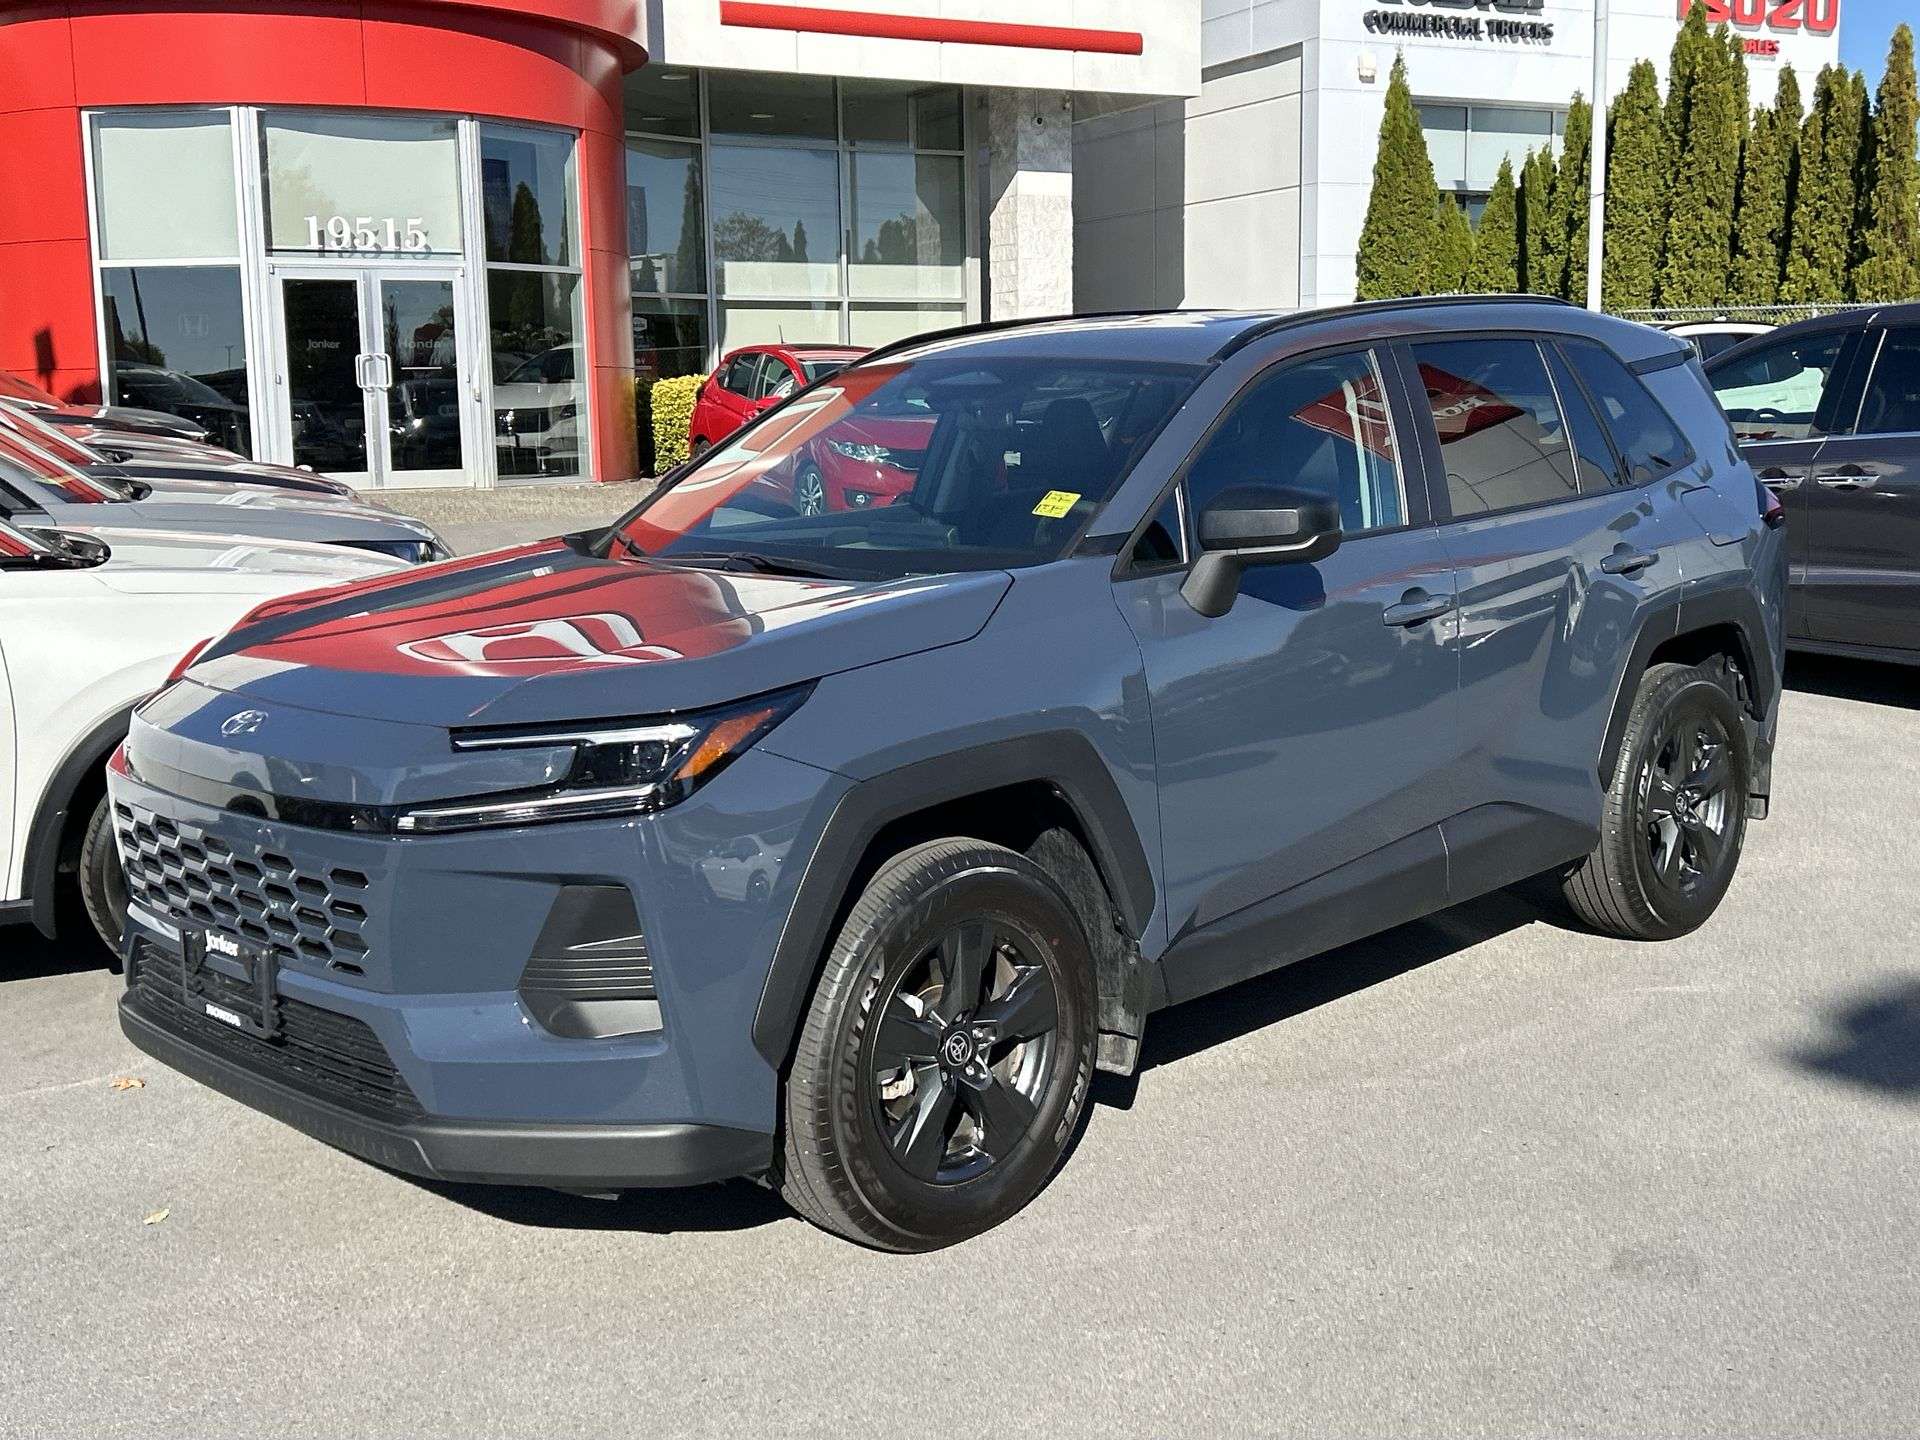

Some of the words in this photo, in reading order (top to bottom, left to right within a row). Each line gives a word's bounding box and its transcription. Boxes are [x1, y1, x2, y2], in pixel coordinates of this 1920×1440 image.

[1363, 10, 1484, 37] COMMERCIAL
[1485, 19, 1554, 41] TRUCKS
[304, 215, 427, 250] 19515
[307, 339, 341, 350] Jonker
[399, 339, 441, 349] Honda
